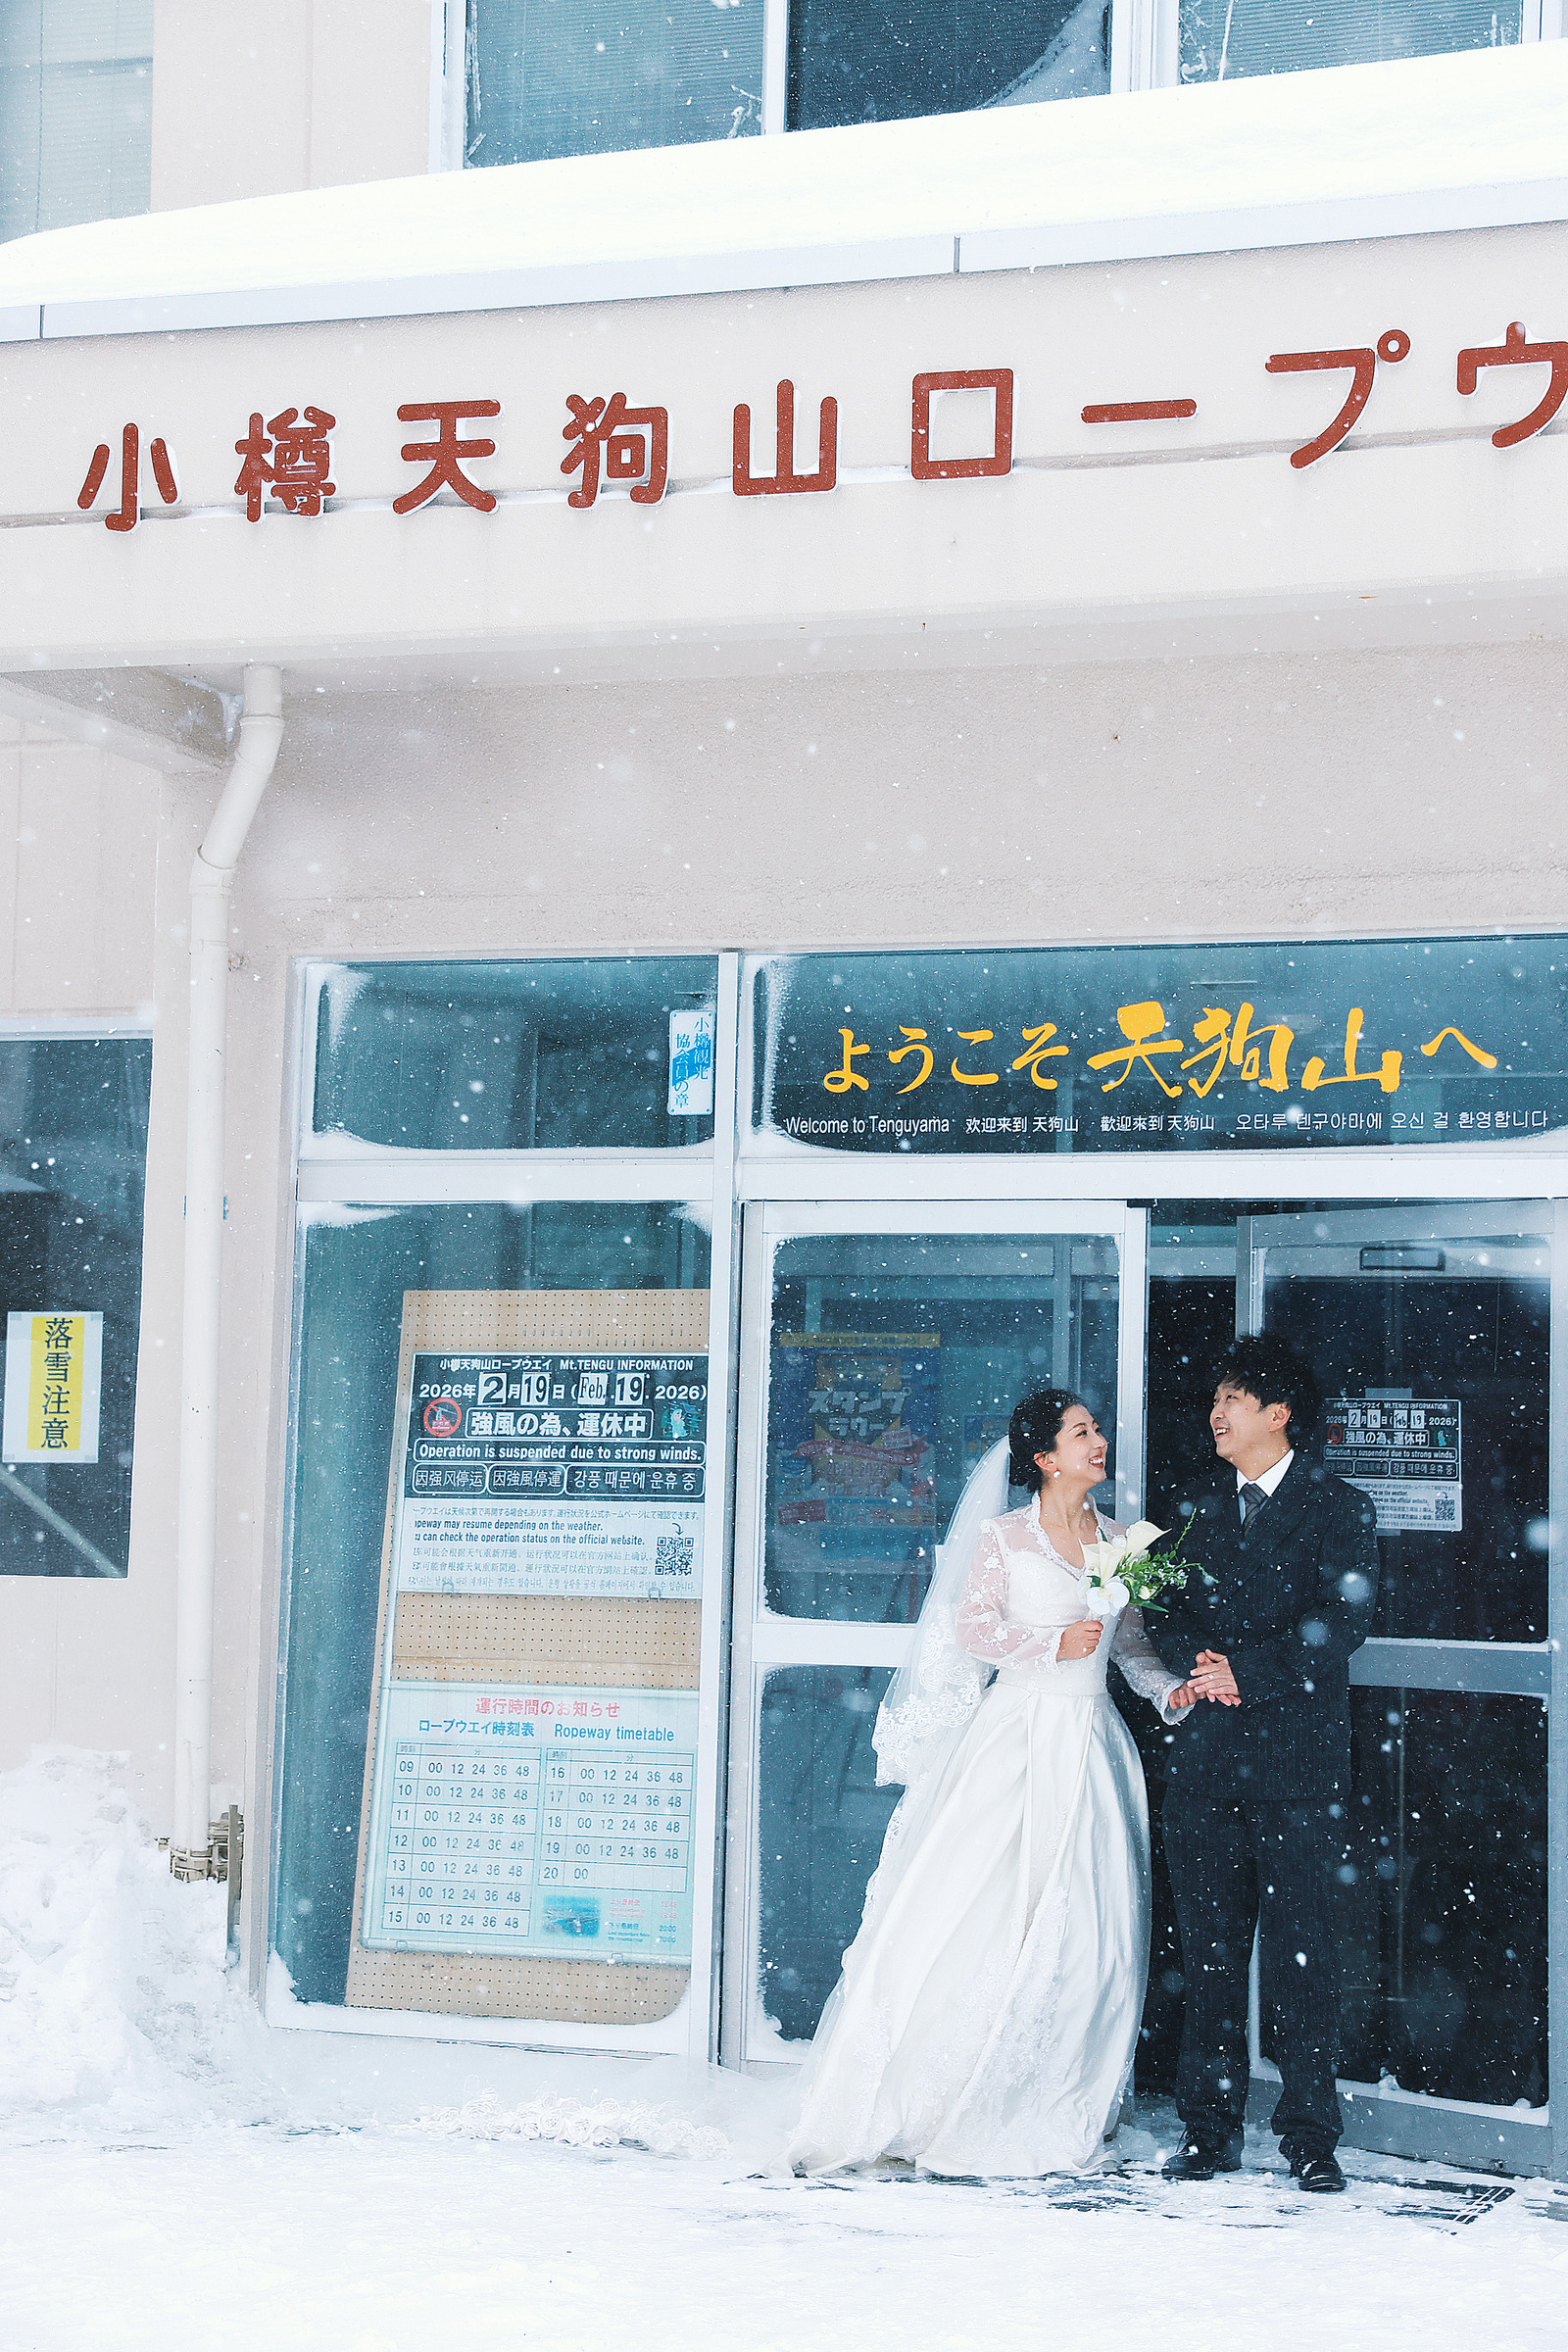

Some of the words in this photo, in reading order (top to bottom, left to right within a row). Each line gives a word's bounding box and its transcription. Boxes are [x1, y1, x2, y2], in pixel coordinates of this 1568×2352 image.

[785, 1116, 849, 1134] Welcome
[853, 1117, 865, 1134] to
[868, 1115, 950, 1137] Tenguyama
[966, 1116, 1027, 1134] 欢迎来到
[1032, 1115, 1079, 1133] 天狗山
[1167, 1114, 1214, 1131] 天狗山
[1236, 1113, 1287, 1131] 오타루
[1391, 1111, 1424, 1129] 오신
[1433, 1111, 1448, 1129] 걸
[1458, 1110, 1548, 1129] 환영합니다
[560, 1359, 613, 1370] Mt.TENGU
[617, 1359, 693, 1370] INFORMATION
[41, 1317, 73, 1448] 落雪注意
[655, 1385, 707, 1400] 2026)
[470, 1411, 646, 1437] 強風の為、運休中
[1345, 1431, 1426, 1445] 強風の為、運休中
[419, 1444, 480, 1457] Operation
[485, 1444, 495, 1457] is
[499, 1445, 565, 1459] suspended
[570, 1446, 594, 1459] due
[598, 1446, 611, 1459] to
[614, 1446, 656, 1460] strong
[660, 1446, 701, 1460] winds.
[1403, 1449, 1410, 1458] to
[1411, 1449, 1432, 1459] strong
[415, 1470, 482, 1487] 因强风停运
[493, 1470, 561, 1487] 因強風停運
[574, 1470, 601, 1488] 강풍
[605, 1470, 645, 1489] 때문에
[650, 1471, 677, 1490] 운휴
[682, 1472, 696, 1490] 중
[444, 1520, 461, 1530] may
[463, 1520, 493, 1529] resume
[494, 1519, 536, 1531] depending
[539, 1521, 549, 1530] on
[551, 1520, 564, 1530] the
[567, 1520, 603, 1531] weather.
[422, 1533, 437, 1542] can
[439, 1531, 463, 1542] check
[466, 1532, 478, 1543] the
[481, 1532, 519, 1543] operation
[521, 1533, 548, 1544] status
[563, 1534, 576, 1544] the
[578, 1534, 609, 1544] official
[611, 1535, 645, 1545] website.
[476, 1697, 619, 1717] 運行時間のお知らせ
[418, 1719, 534, 1737] ロープウエイ時刻表
[555, 1724, 612, 1740] Ropeway
[616, 1726, 674, 1741] timetable
[399, 1760, 414, 1772] 09
[428, 1762, 443, 1773] 00
[452, 1763, 464, 1775] 12
[471, 1764, 485, 1775] 24
[493, 1765, 508, 1776] 36
[515, 1765, 529, 1777] 48
[551, 1767, 564, 1778] 16
[580, 1768, 595, 1780] 00
[604, 1770, 616, 1781] 12
[625, 1770, 638, 1782] 24
[647, 1771, 661, 1783] 36
[668, 1772, 683, 1784] 48
[398, 1784, 413, 1795] 10
[426, 1786, 440, 1796] 00
[450, 1788, 463, 1798] 12
[470, 1788, 484, 1799] 24
[492, 1788, 506, 1799] 36
[514, 1789, 528, 1801] 48
[550, 1790, 564, 1802] 17
[578, 1791, 593, 1803] 00
[602, 1793, 615, 1804] 12
[623, 1794, 637, 1805] 24
[646, 1795, 660, 1806] 36
[667, 1796, 682, 1807] 48
[396, 1809, 409, 1821] 11
[424, 1810, 439, 1822] 00
[448, 1811, 461, 1823] 12
[468, 1812, 482, 1824] 24
[490, 1813, 504, 1825] 36
[512, 1814, 526, 1826] 48
[548, 1816, 562, 1828] 18
[577, 1817, 592, 1829] 00
[601, 1819, 614, 1830] 12
[621, 1819, 636, 1831] 24
[644, 1821, 659, 1832] 36
[665, 1822, 680, 1833] 48
[394, 1835, 408, 1846] 12
[422, 1837, 437, 1847] 00
[446, 1838, 459, 1848] 12
[466, 1838, 480, 1849] 24
[488, 1838, 502, 1850] 36
[511, 1840, 524, 1851] 48
[546, 1841, 560, 1853] 19
[575, 1843, 590, 1855] 00
[600, 1845, 612, 1856] 12
[620, 1846, 634, 1857] 24
[642, 1847, 657, 1858] 36
[664, 1848, 679, 1859] 48
[392, 1859, 406, 1872] 13
[420, 1861, 435, 1873] 00
[443, 1863, 457, 1874] 12
[465, 1863, 478, 1875] 24
[486, 1864, 501, 1876] 36
[509, 1866, 522, 1877] 48
[544, 1867, 559, 1879] 20
[574, 1868, 589, 1880] 00
[391, 1885, 405, 1897] 14
[418, 1886, 433, 1898] 00
[442, 1888, 455, 1900] 12
[463, 1889, 476, 1900] 24
[484, 1890, 499, 1901] 36
[507, 1891, 521, 1902] 48
[388, 1911, 402, 1923] 15
[416, 1912, 431, 1924] 00
[439, 1913, 453, 1926] 12
[461, 1915, 474, 1926] 24
[482, 1916, 497, 1927] 36
[505, 1917, 519, 1929] 48
